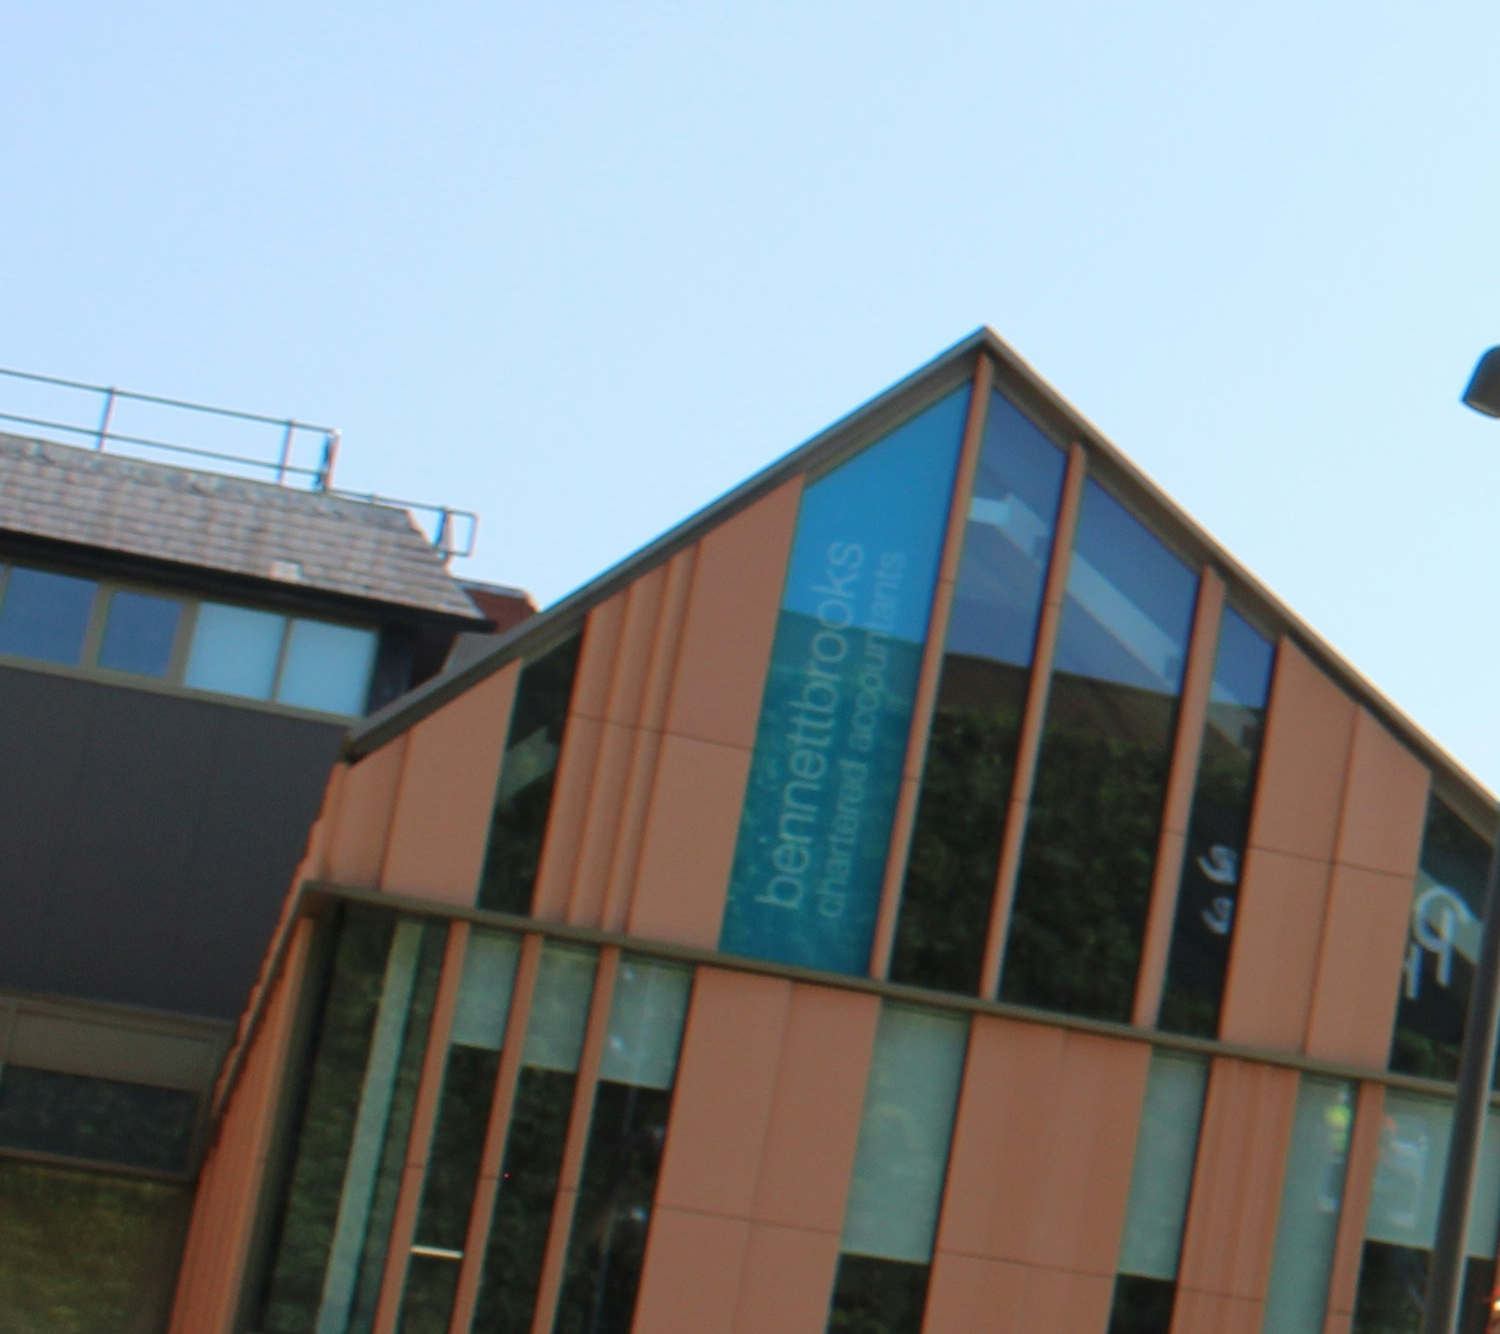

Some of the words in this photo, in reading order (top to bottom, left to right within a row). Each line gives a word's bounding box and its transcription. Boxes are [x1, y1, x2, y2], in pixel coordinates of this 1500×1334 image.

[755, 541, 863, 910] bennettbrooks
[818, 760, 869, 918] chartered
[850, 552, 906, 752] accountants
